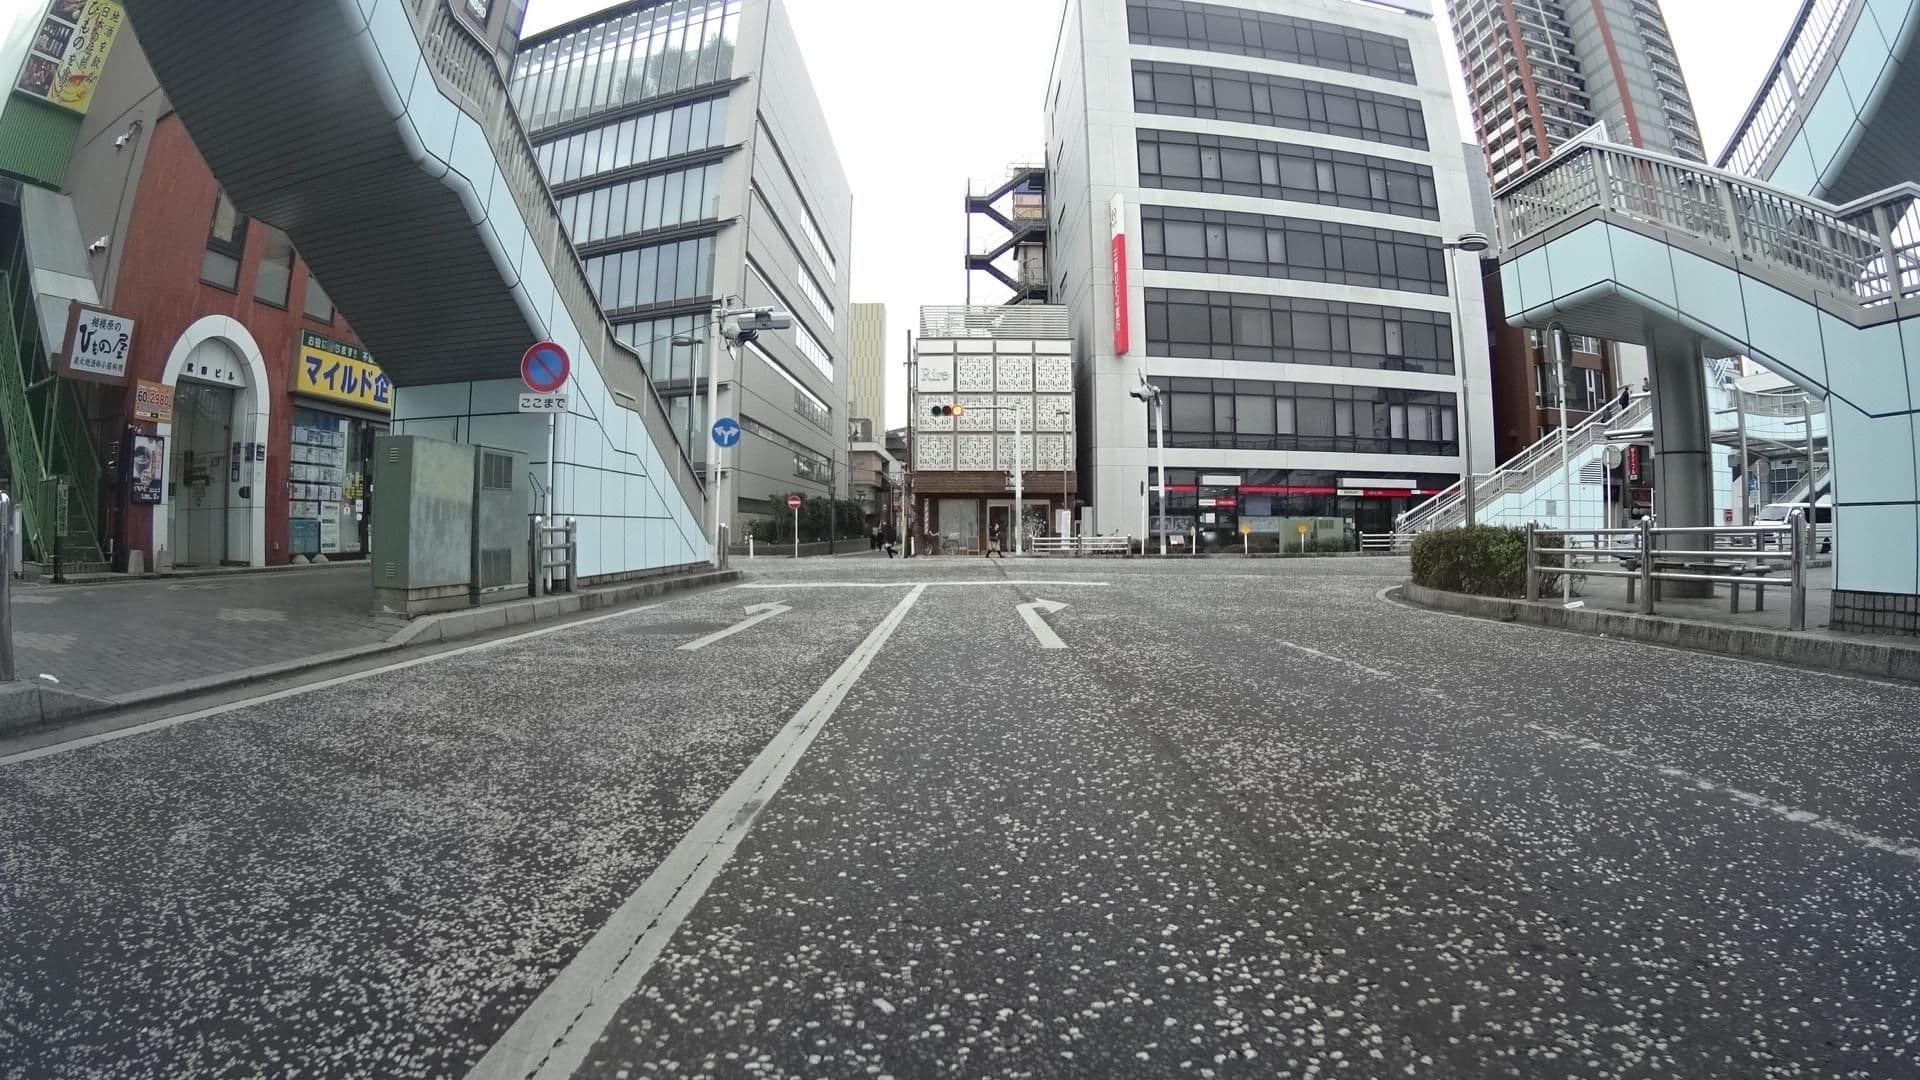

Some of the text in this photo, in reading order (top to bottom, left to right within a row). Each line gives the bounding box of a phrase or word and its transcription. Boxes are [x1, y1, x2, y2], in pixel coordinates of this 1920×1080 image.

[79, 323, 129, 360] ひもの屋
[521, 397, 566, 409] ここまで
